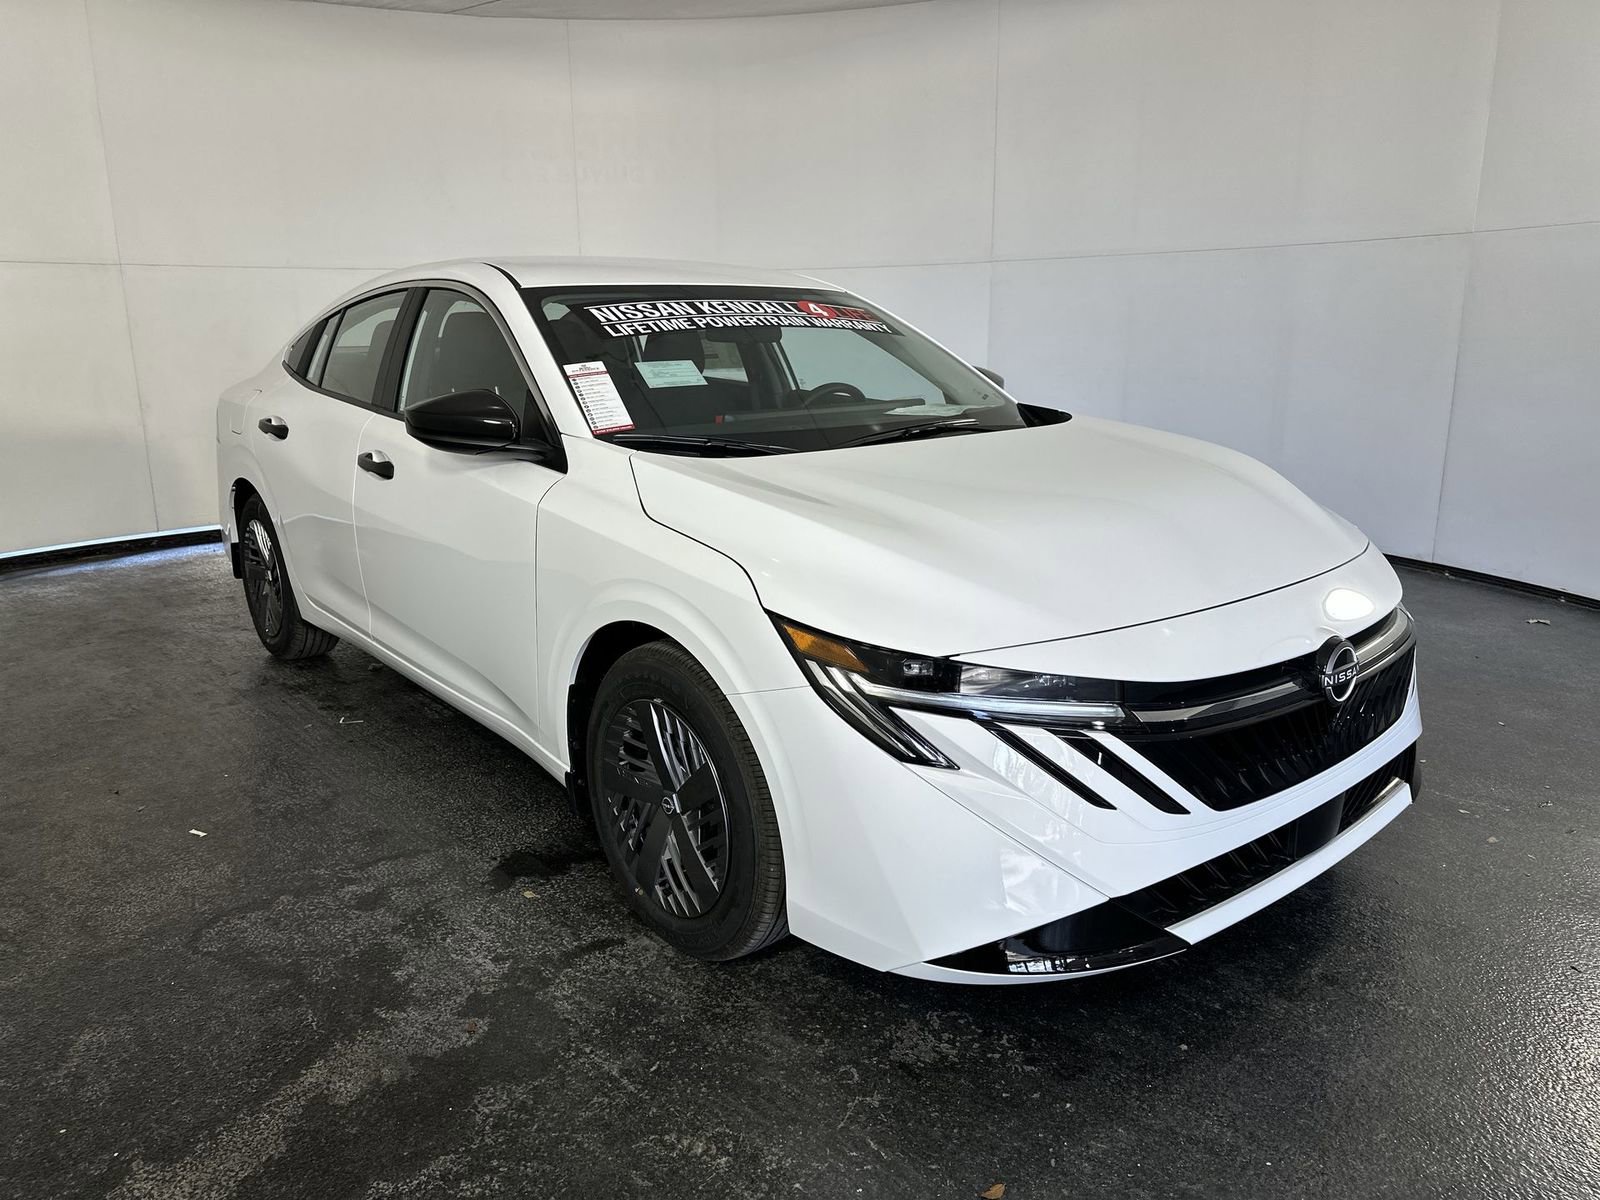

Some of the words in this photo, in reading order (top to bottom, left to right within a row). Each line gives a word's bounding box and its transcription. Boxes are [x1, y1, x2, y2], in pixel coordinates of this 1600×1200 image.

[589, 302, 697, 322] NISSAN
[695, 301, 806, 315] KENDALL
[808, 303, 829, 317] 4
[831, 307, 876, 321] LIFE
[603, 318, 697, 337] LIFETIME
[693, 315, 808, 329] POWERTRAIN
[807, 317, 893, 334] WARRANTY
